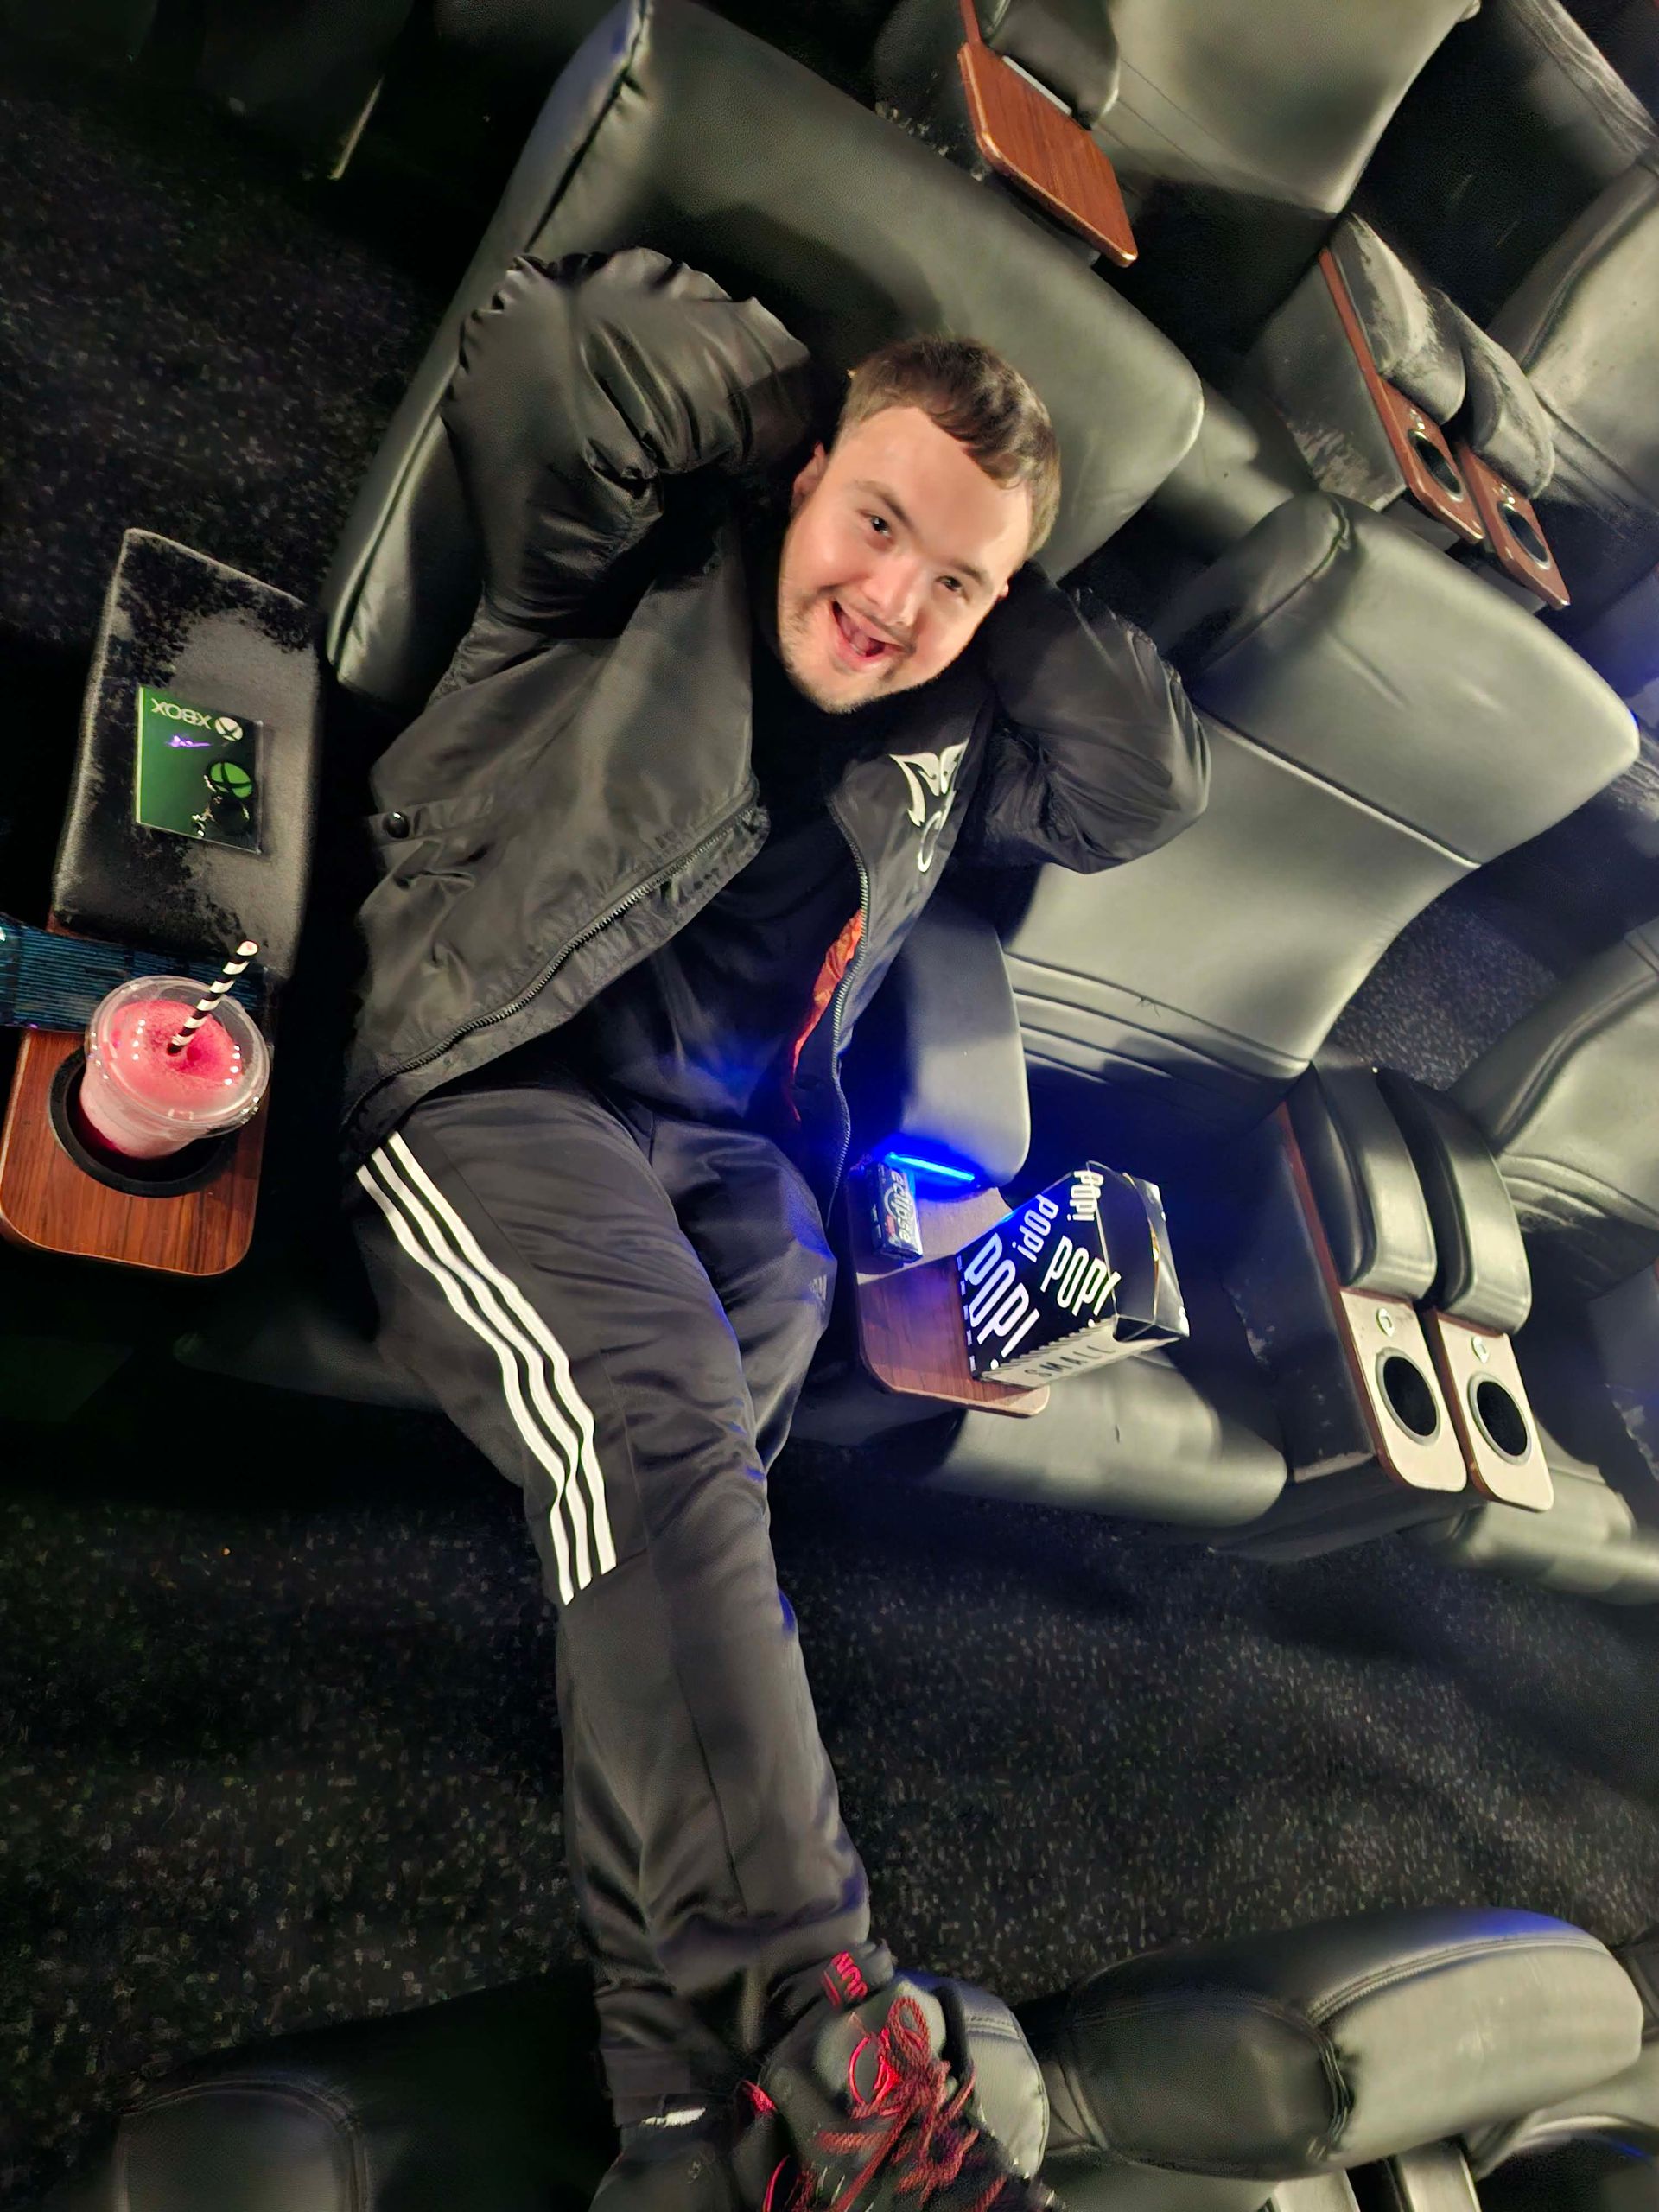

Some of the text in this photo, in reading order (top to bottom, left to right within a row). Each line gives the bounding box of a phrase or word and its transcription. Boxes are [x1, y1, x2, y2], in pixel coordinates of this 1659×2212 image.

[150, 697, 213, 731] XBOX
[891, 1170, 912, 1244] eclipse
[1012, 1193, 1059, 1262] POP!
[1067, 1170, 1104, 1222] POP!
[964, 1232, 1040, 1370] POP!
[1040, 1235, 1122, 1329] POP!
[1024, 1344, 1116, 1377] SMALL
